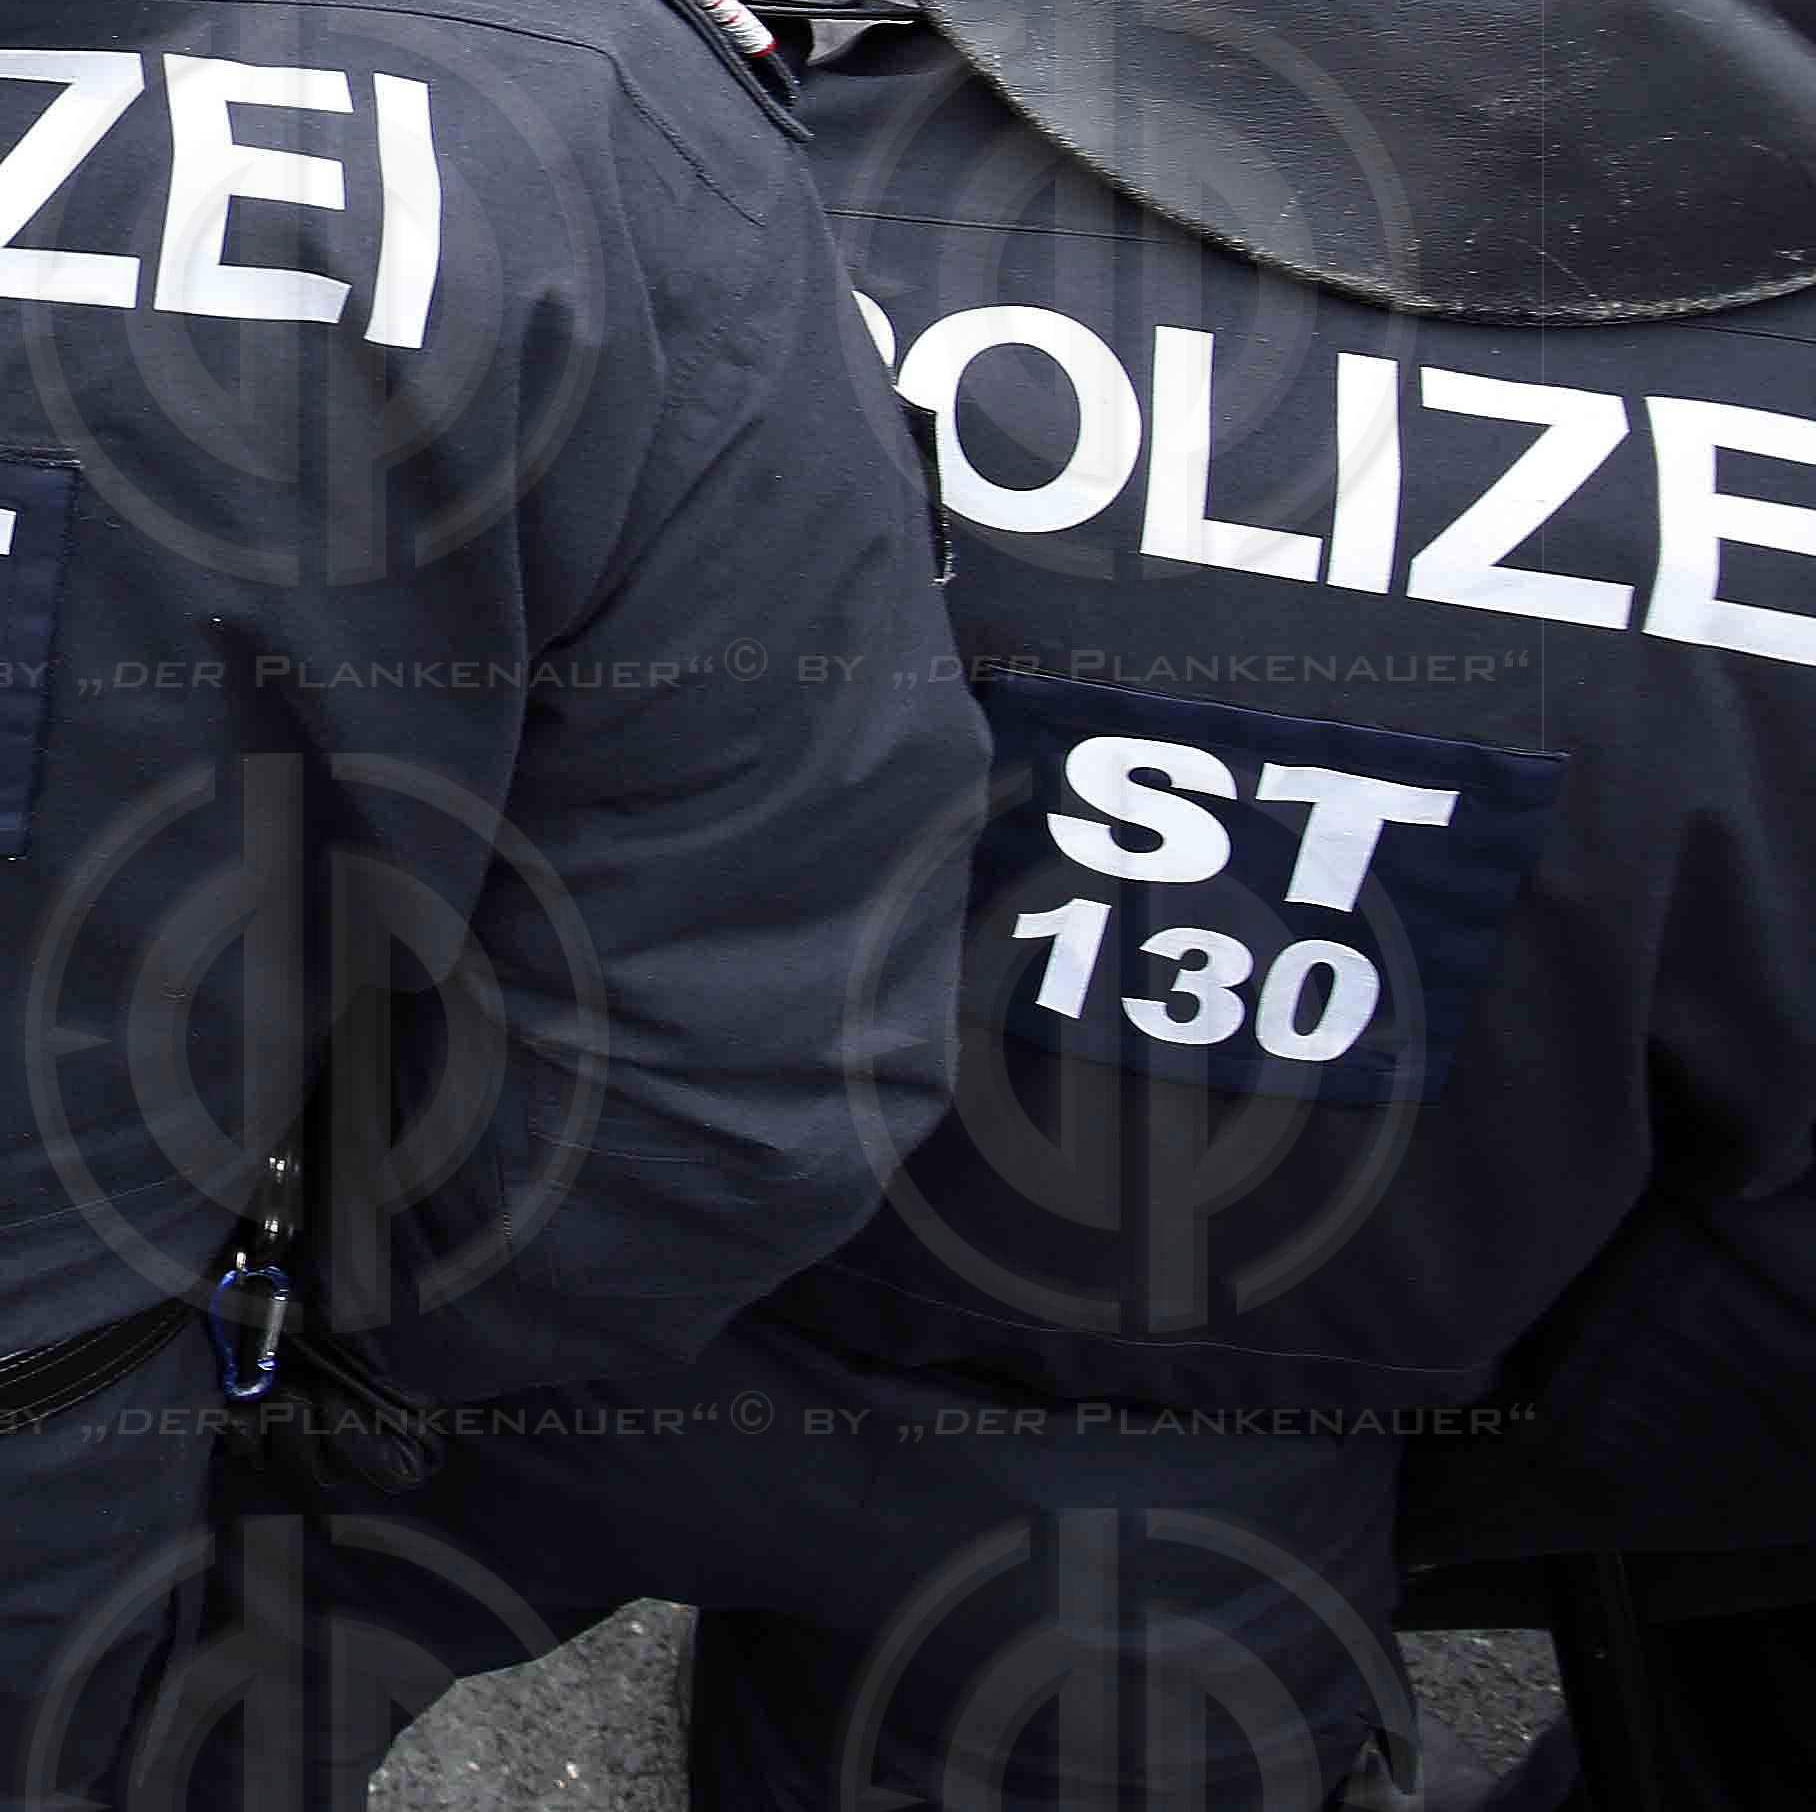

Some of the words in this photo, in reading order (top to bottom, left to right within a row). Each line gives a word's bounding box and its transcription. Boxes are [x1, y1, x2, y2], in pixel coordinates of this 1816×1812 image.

[851, 289, 1816, 666] OLIZE
[1047, 736, 1459, 913] ST
[1012, 898, 1380, 1062] 130
